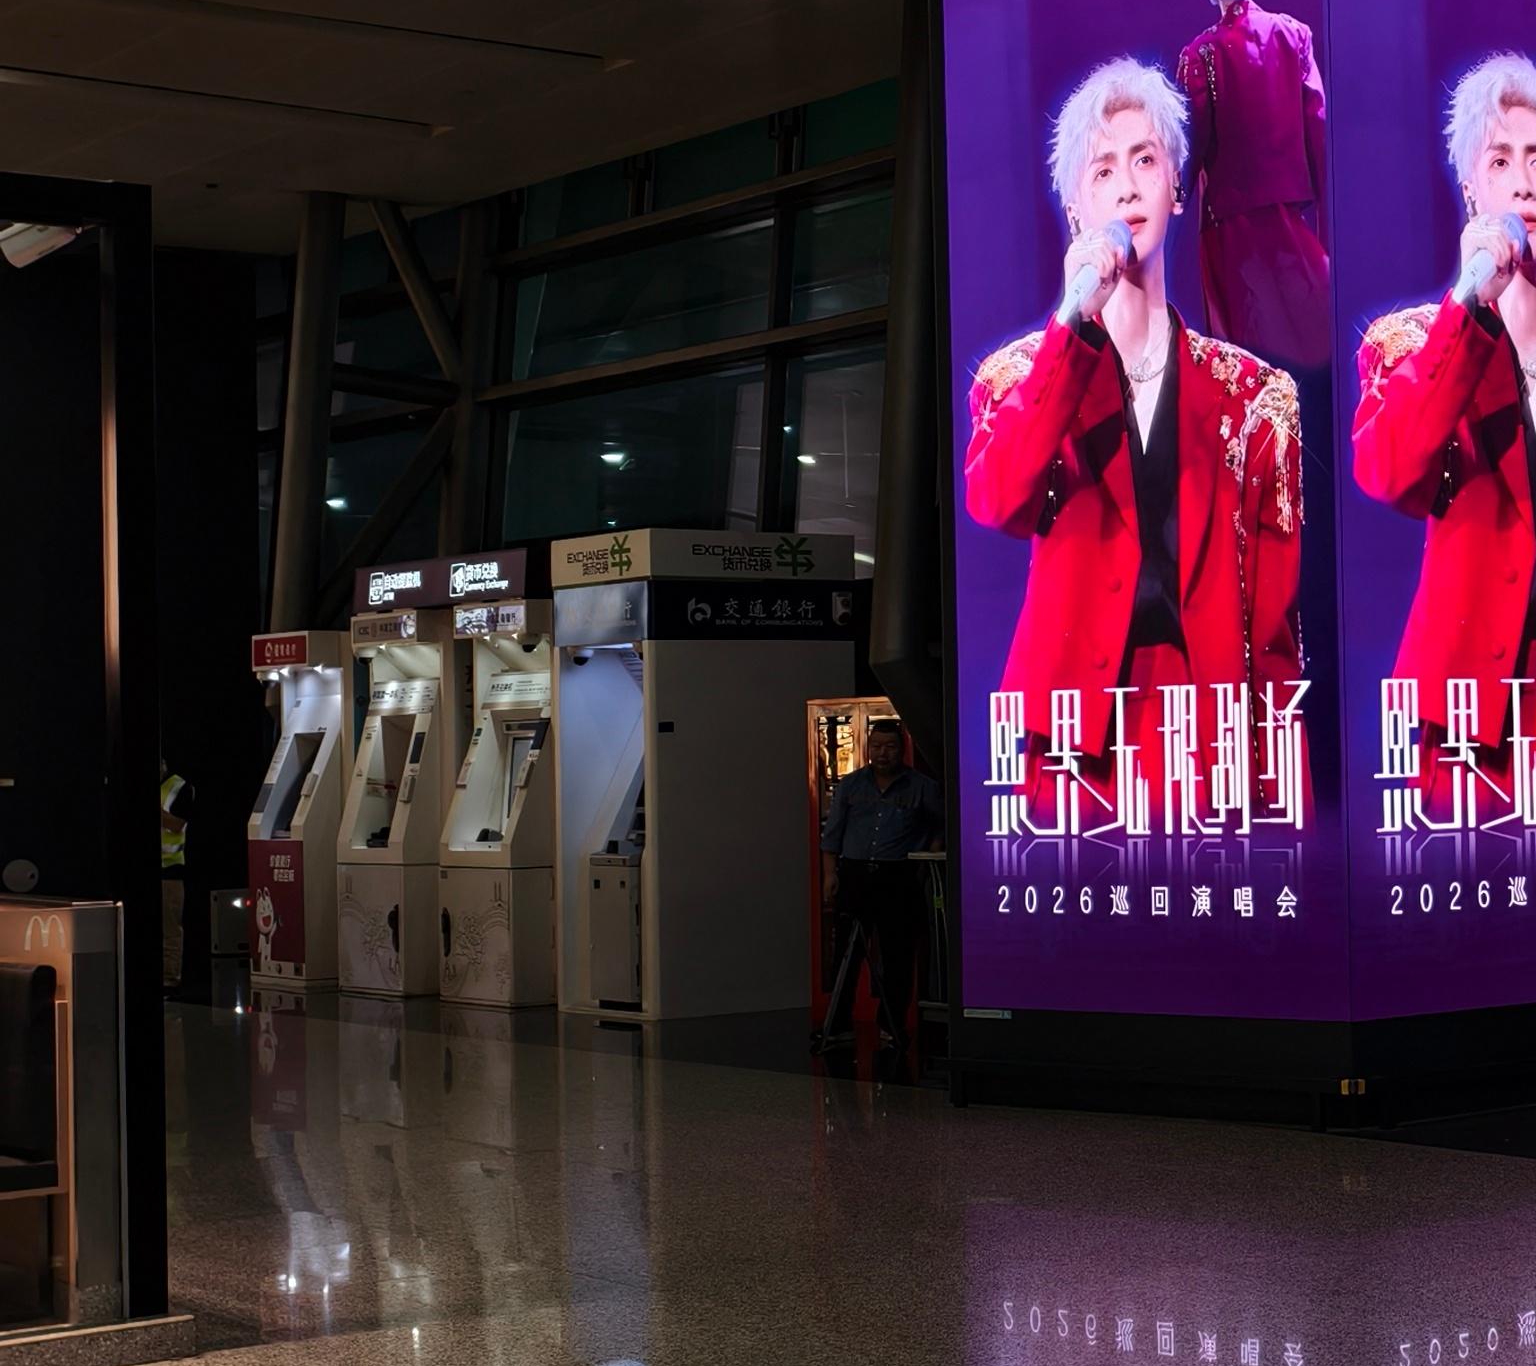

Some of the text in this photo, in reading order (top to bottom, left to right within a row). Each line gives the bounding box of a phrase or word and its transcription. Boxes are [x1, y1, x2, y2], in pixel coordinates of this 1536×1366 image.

[567, 548, 609, 564] EXCHANGE
[692, 544, 772, 558] EXCHANGE
[722, 557, 772, 572] 货币兑换
